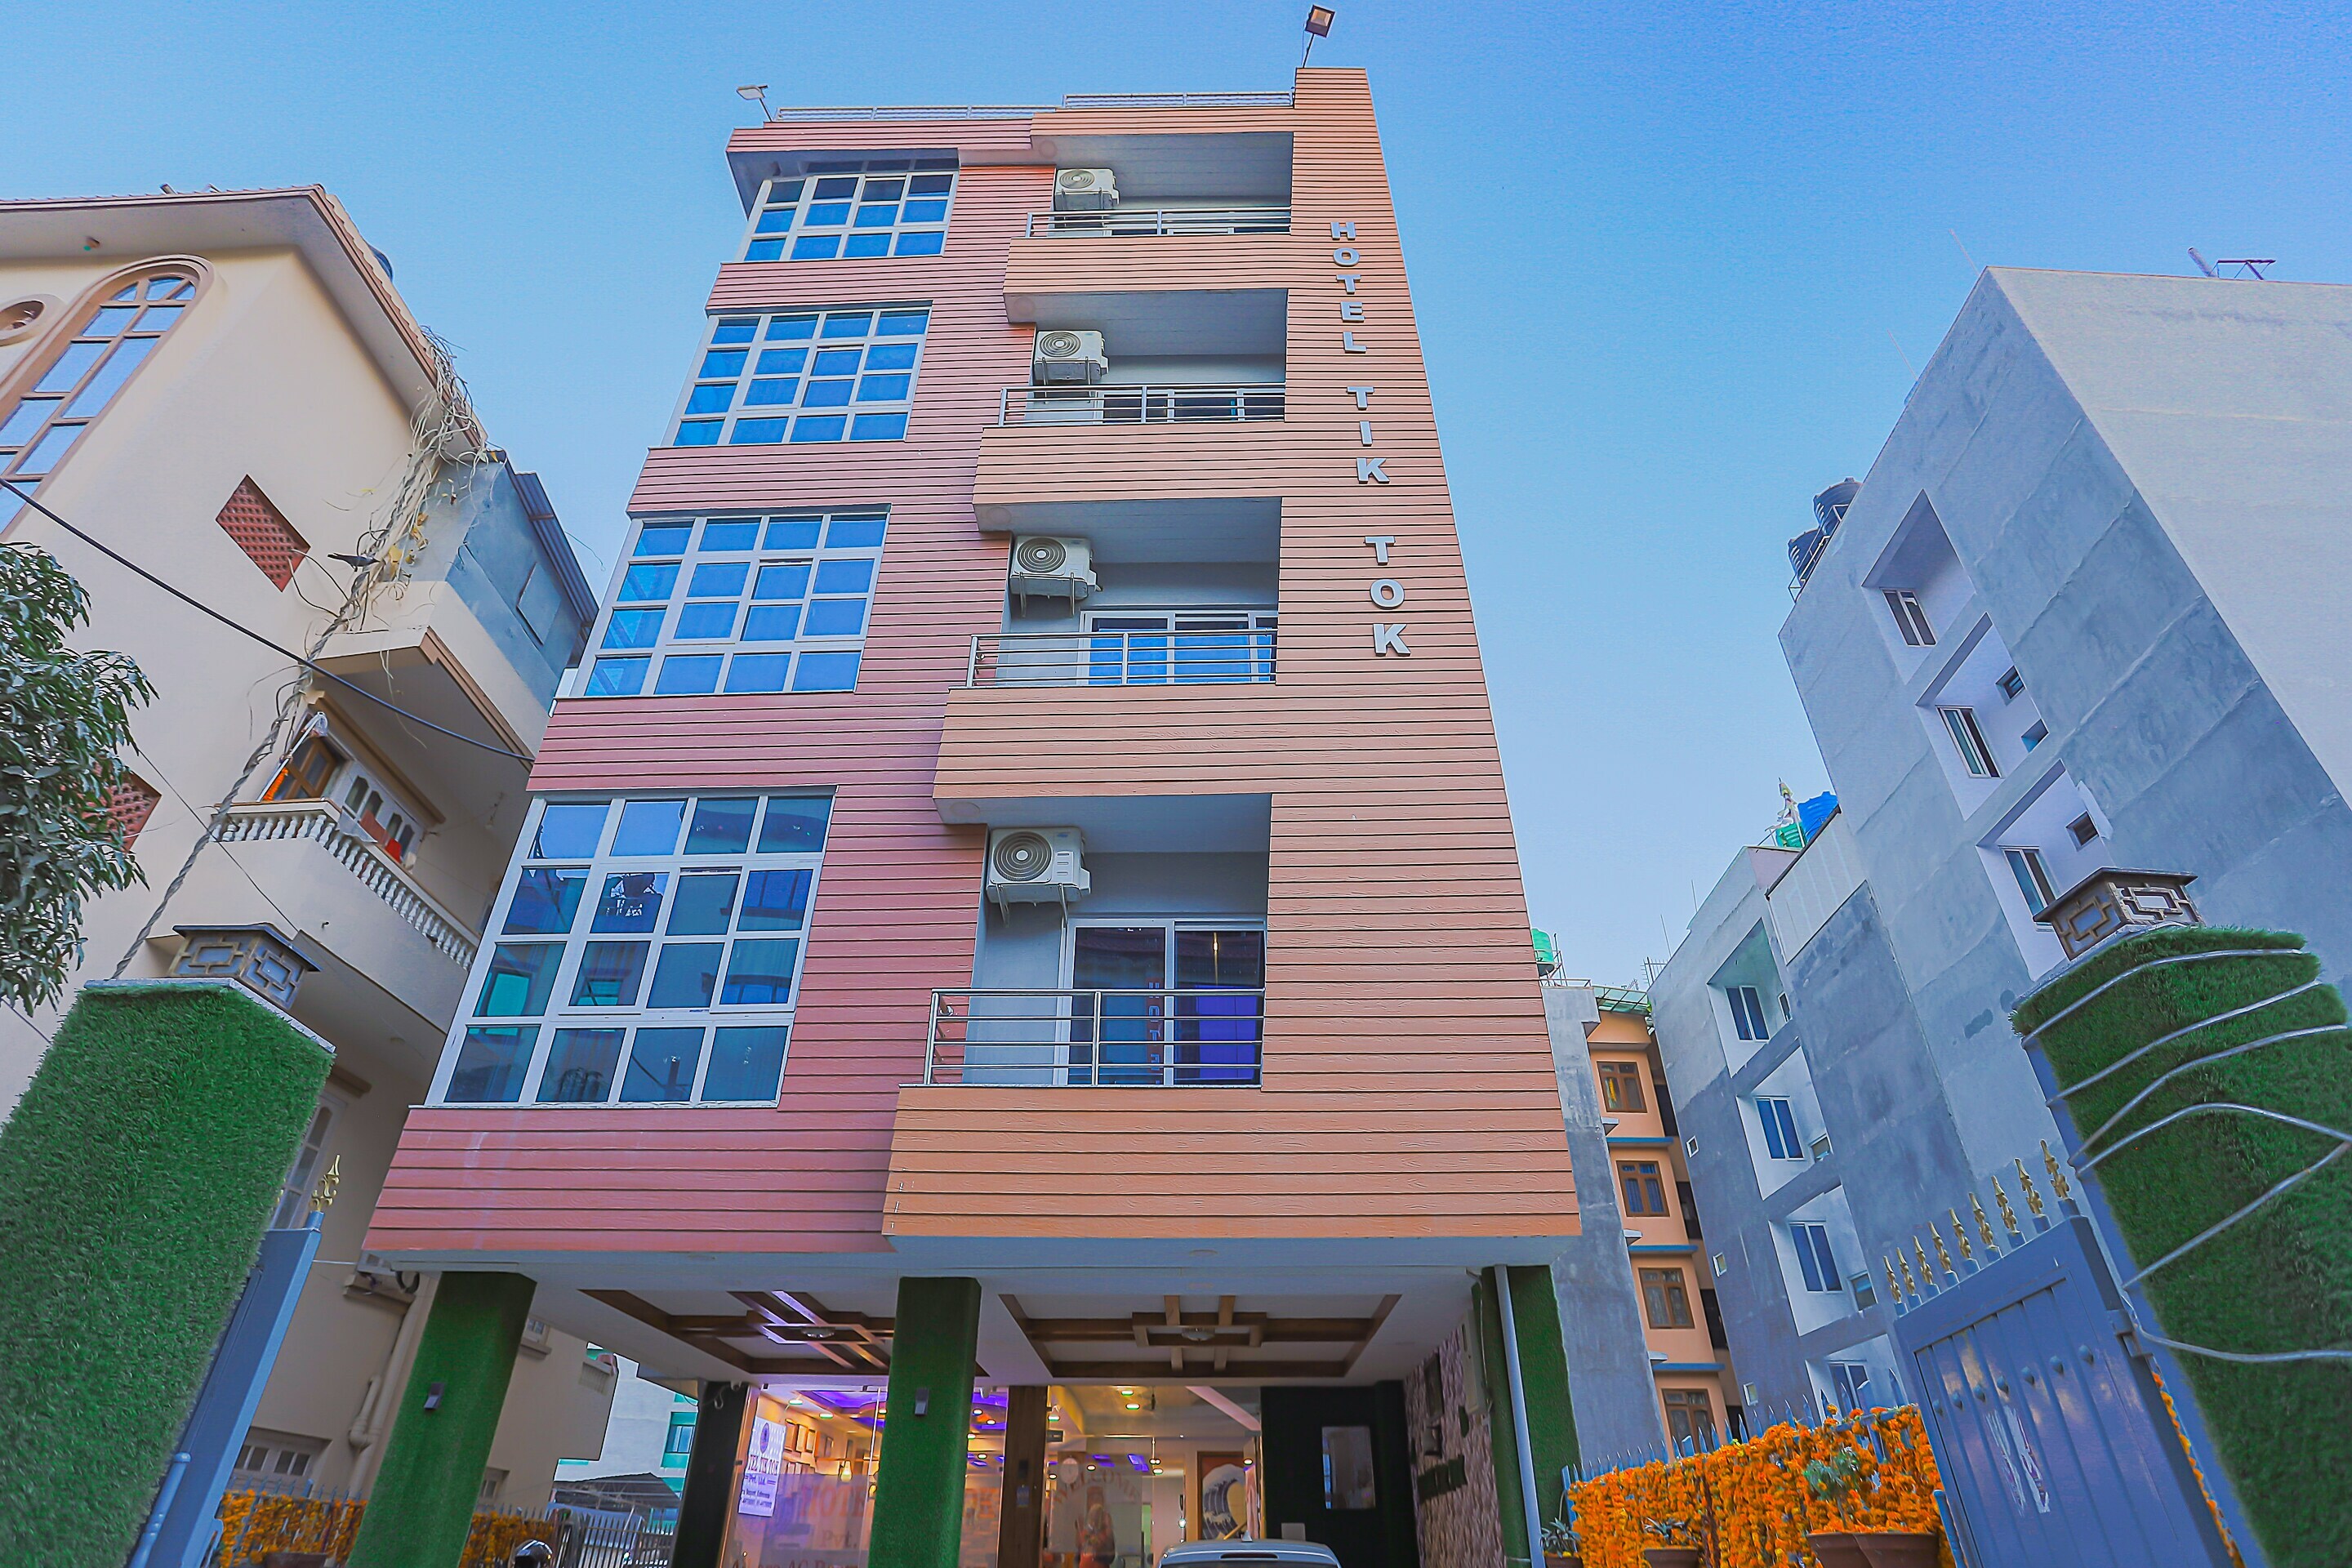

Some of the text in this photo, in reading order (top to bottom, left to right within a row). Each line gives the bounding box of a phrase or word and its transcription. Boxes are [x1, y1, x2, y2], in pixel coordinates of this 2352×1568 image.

[1330, 220, 1412, 657] HOTEL TIK TOK
